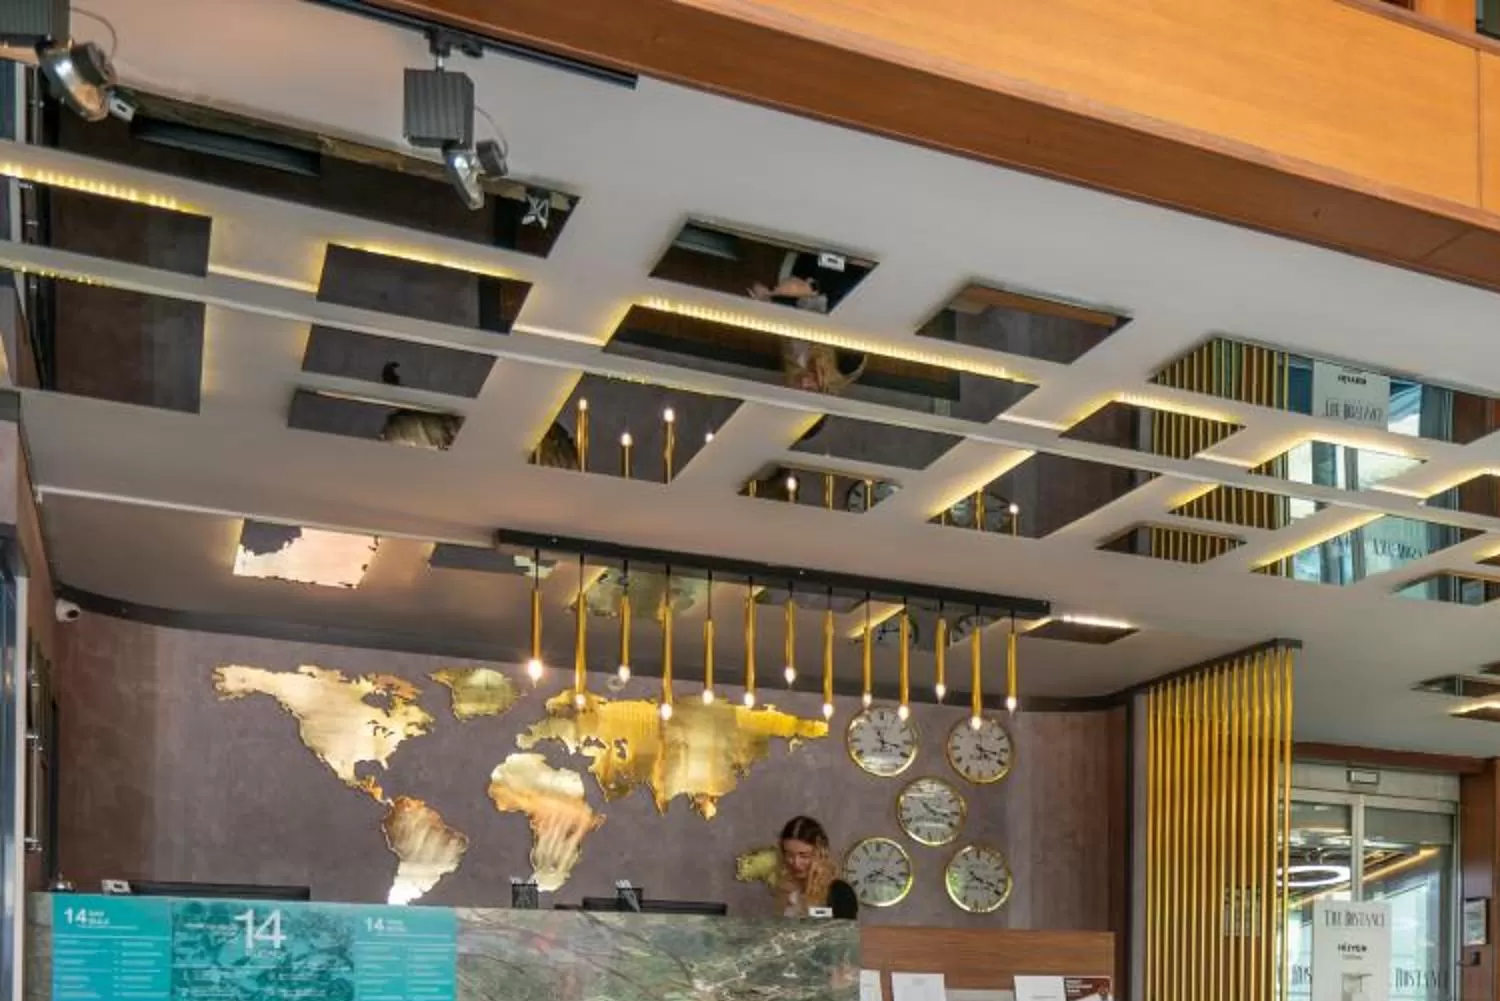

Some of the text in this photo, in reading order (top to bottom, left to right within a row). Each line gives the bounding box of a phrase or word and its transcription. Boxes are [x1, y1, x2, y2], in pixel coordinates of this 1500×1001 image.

[63, 907, 87, 924] 14
[234, 909, 287, 949] 14
[362, 917, 385, 932] 14
